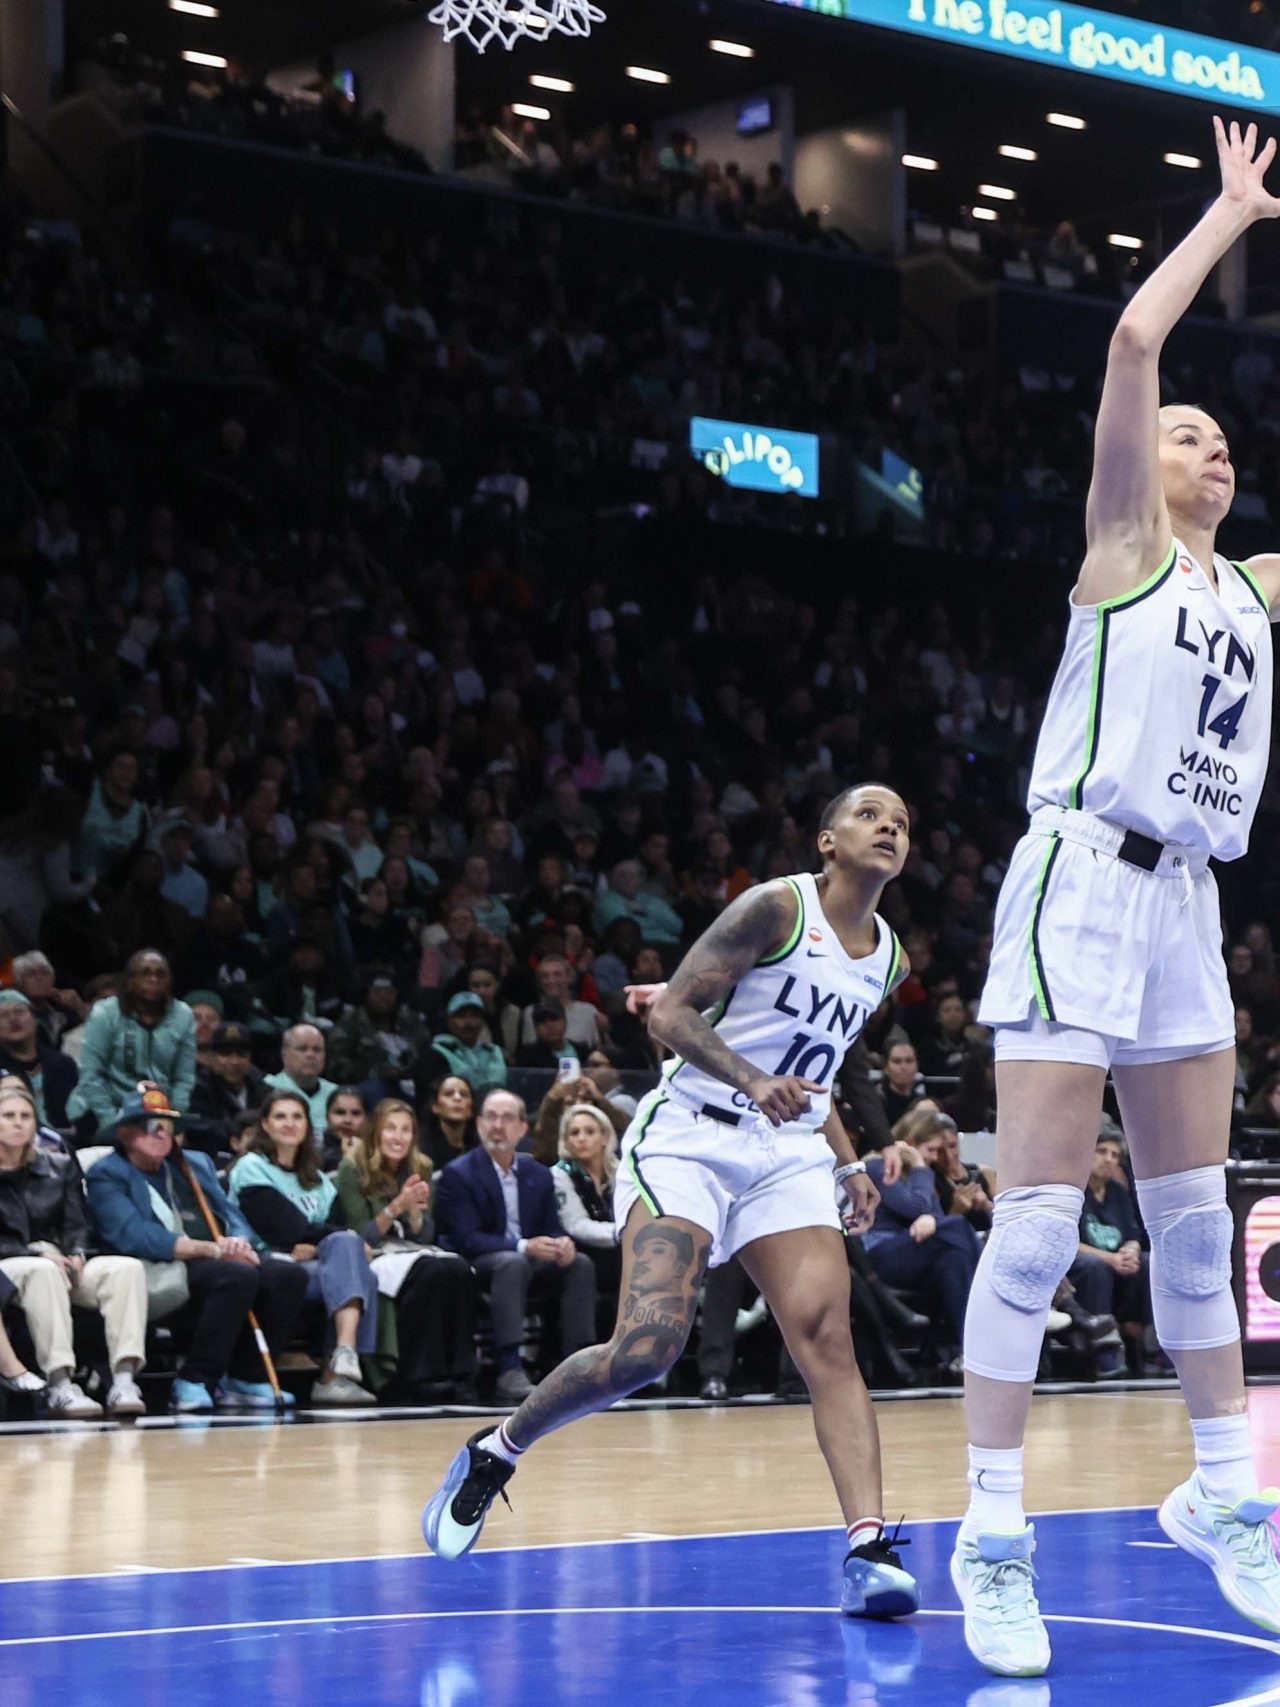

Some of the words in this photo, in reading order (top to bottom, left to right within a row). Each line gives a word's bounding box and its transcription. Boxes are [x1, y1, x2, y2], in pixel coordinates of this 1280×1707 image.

[989, 0, 1064, 54] feel
[1069, 21, 1166, 77] good
[1171, 51, 1264, 100] soda
[1174, 606, 1257, 686] LYN
[1197, 673, 1249, 751] 14
[1167, 772, 1243, 816] CINIC
[1180, 744, 1238, 786] MAYO
[773, 1031, 836, 1085] 10
